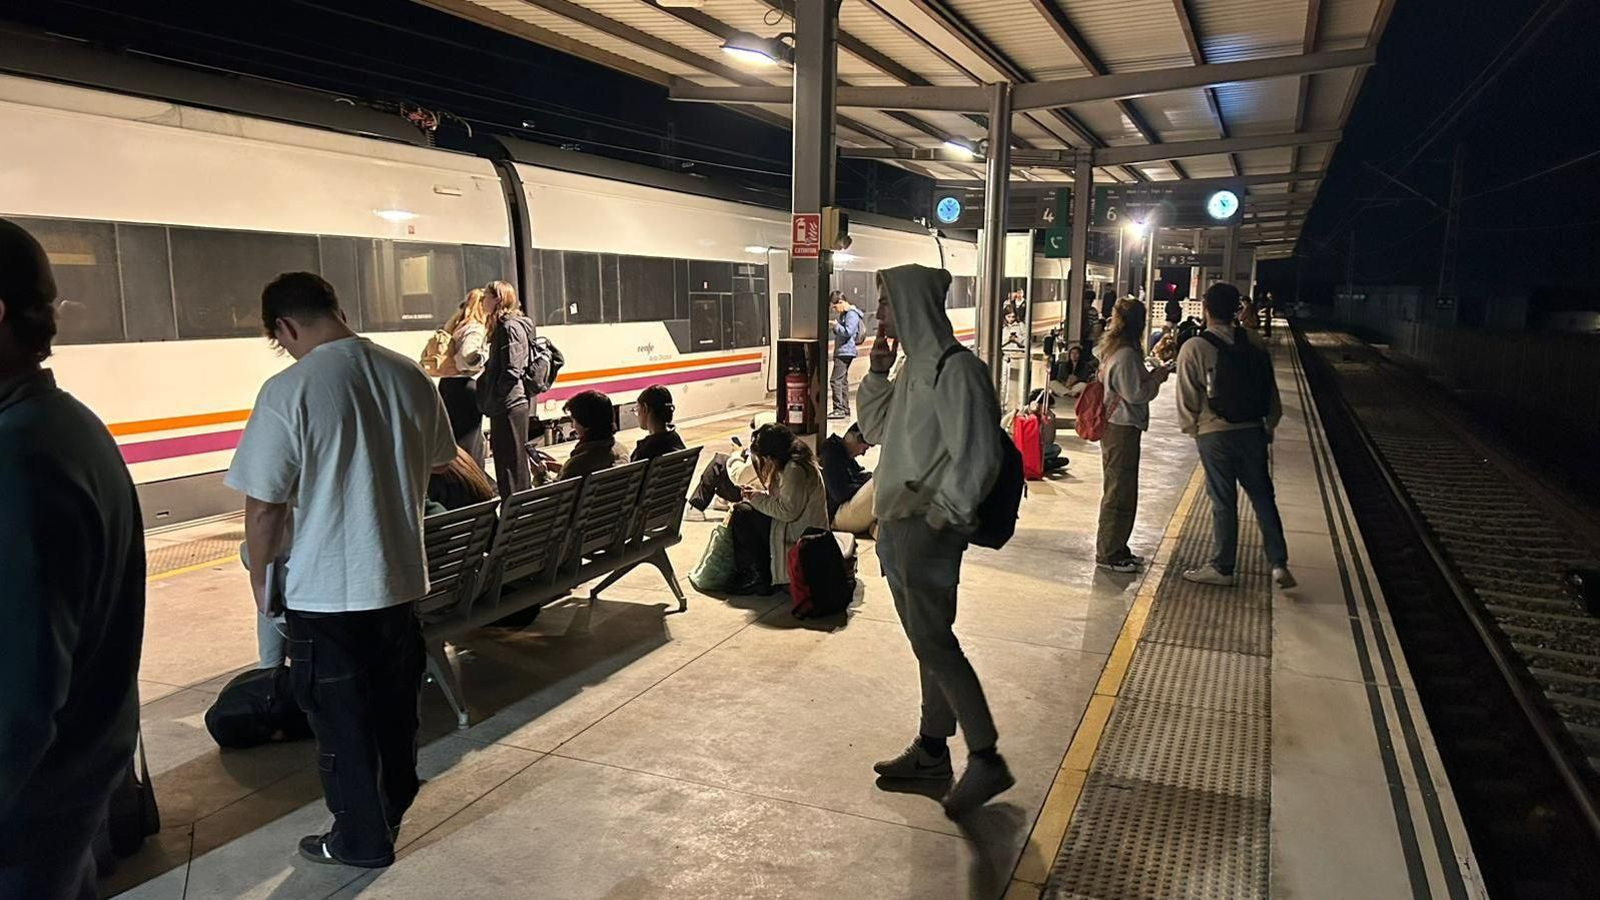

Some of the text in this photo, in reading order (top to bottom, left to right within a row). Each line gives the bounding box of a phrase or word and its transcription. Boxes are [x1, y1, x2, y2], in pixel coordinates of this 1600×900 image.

[1042, 207, 1055, 223] 4
[1106, 206, 1118, 221] 6
[1179, 256, 1186, 265] 3
[637, 341, 655, 355] renfe
